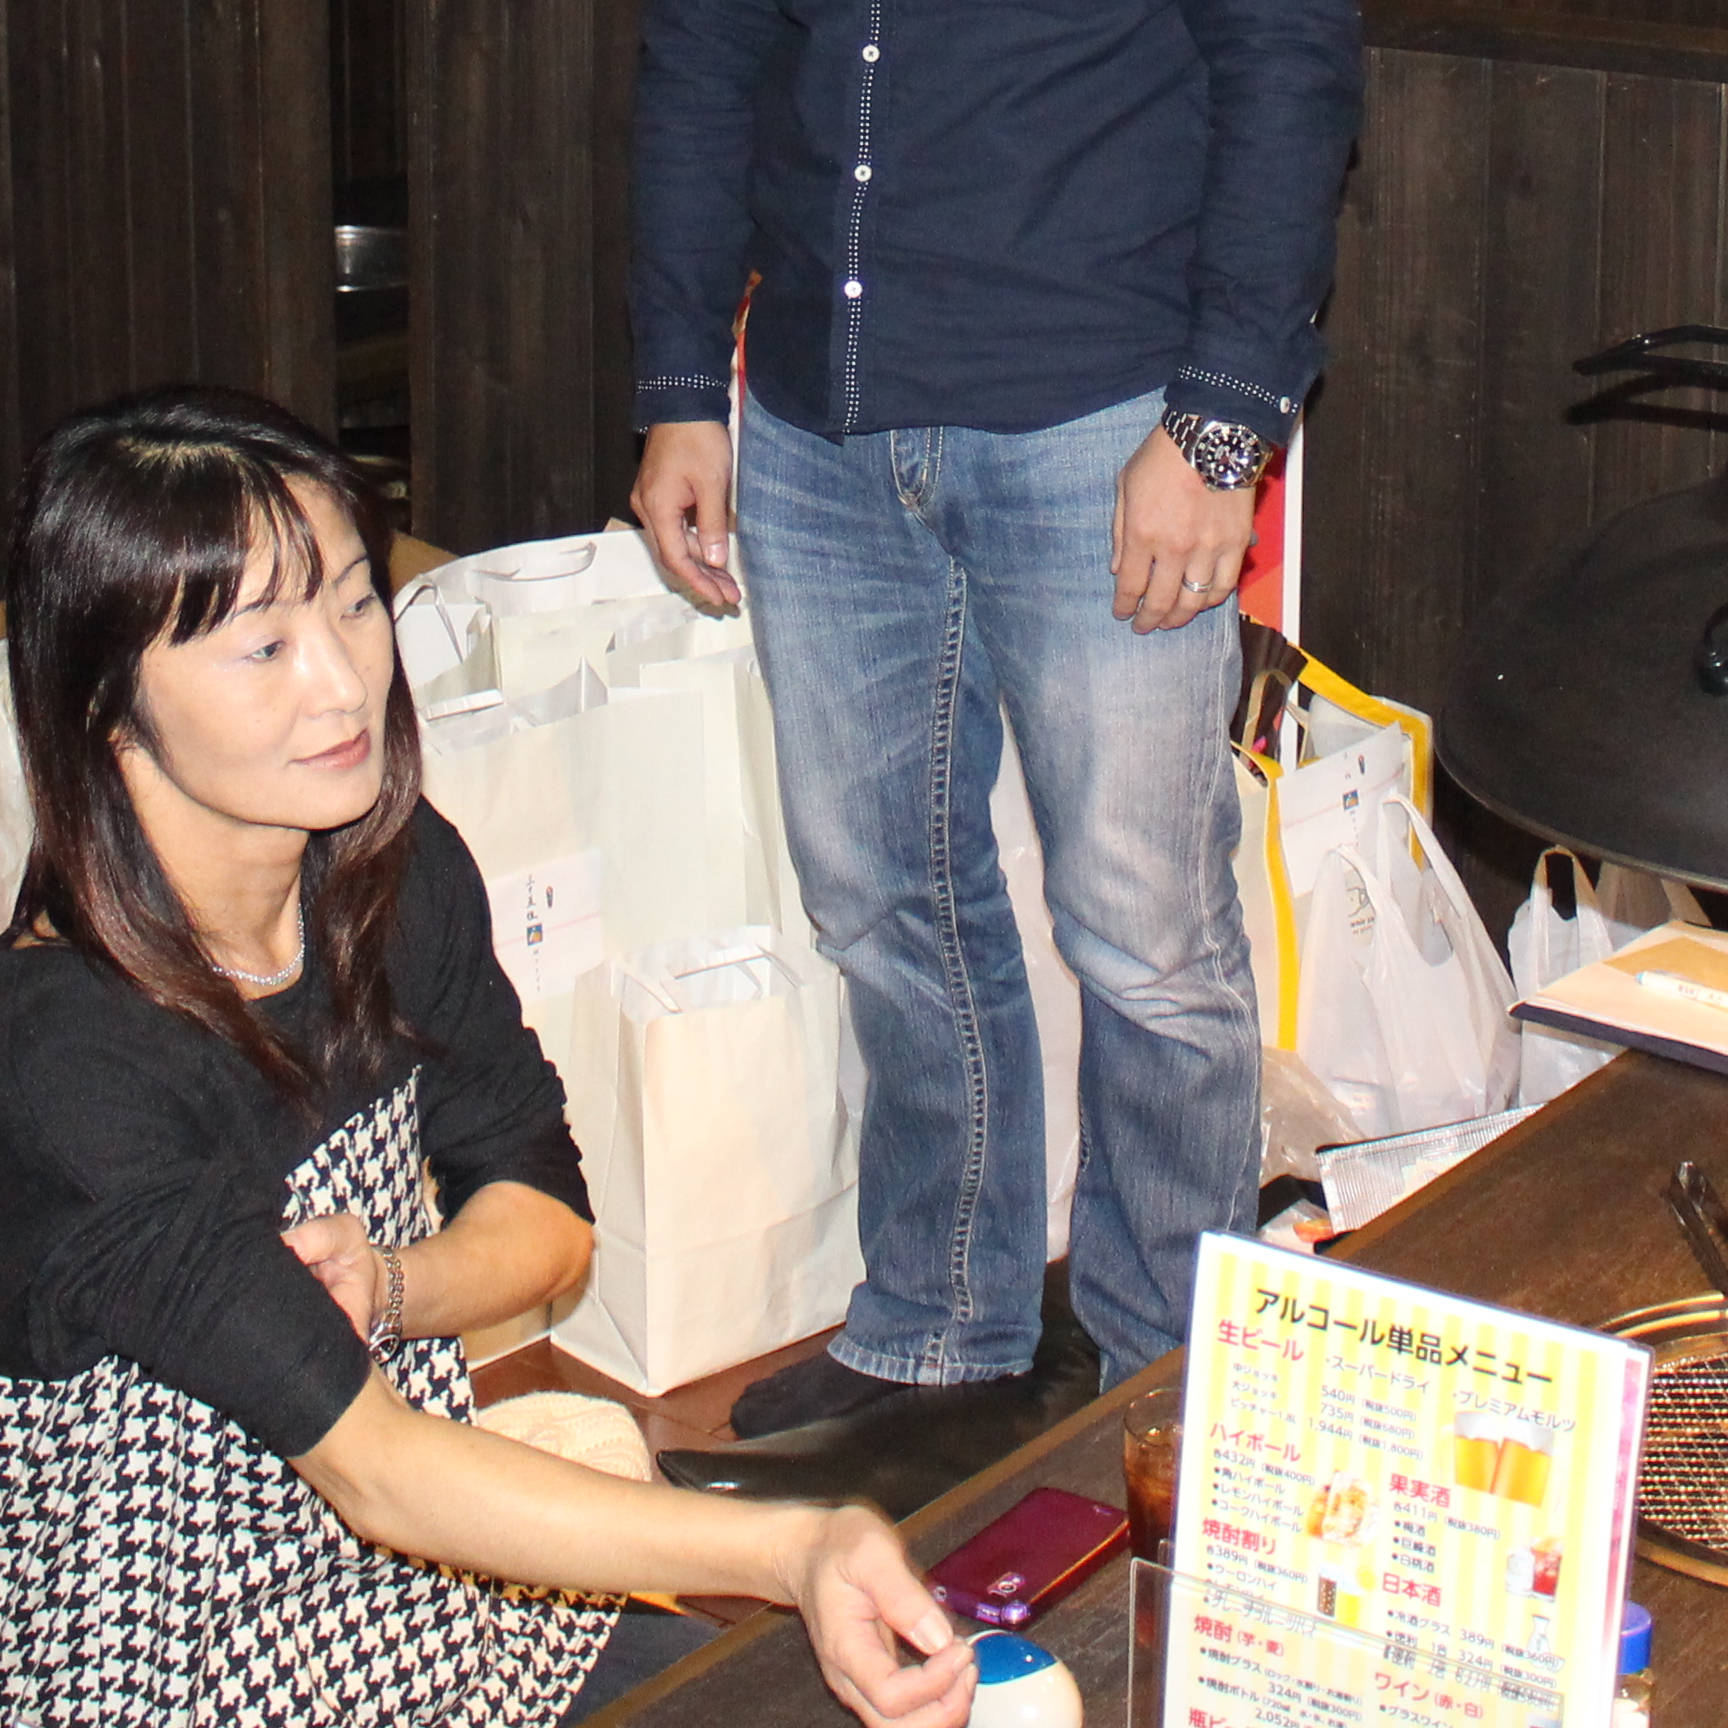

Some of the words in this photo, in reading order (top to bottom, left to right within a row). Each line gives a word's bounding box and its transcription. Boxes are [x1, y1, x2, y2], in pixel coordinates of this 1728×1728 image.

[1217, 1319, 1305, 1362] 生ビール
[1255, 1287, 1553, 1385] アルコール単品メニュー
[1232, 1362, 1280, 1383] 中ジョッキ
[1321, 1385, 1356, 1406] 540円
[1319, 1402, 1355, 1423] 735円
[1210, 1422, 1301, 1462] ハイボール
[1213, 1448, 1256, 1469] 各432円
[1220, 1483, 1304, 1517] レモンハイボール
[1389, 1472, 1452, 1509] 果実酒
[1219, 1499, 1303, 1533] コークハイボール
[1393, 1501, 1438, 1523] 各411円
[1202, 1517, 1276, 1556] 焼酎割り
[1403, 1521, 1426, 1538] 梅酒
[1206, 1544, 1249, 1566] 各389円
[1214, 1564, 1277, 1592] ウーロンハイ
[1382, 1571, 1443, 1608] 日本酒
[1194, 1614, 1233, 1643] 焼酎
[1394, 1610, 1451, 1637] 冷酒グラス
[1459, 1628, 1496, 1650] 389円
[1208, 1648, 1262, 1674] 焼酎グラス
[1458, 1649, 1494, 1670] 324円
[1206, 1677, 1259, 1703] 焼酎ボトル
[1268, 1681, 1303, 1703] 324円
[1375, 1672, 1430, 1701] ワイン
[1434, 1692, 1485, 1720] （赤・白）
